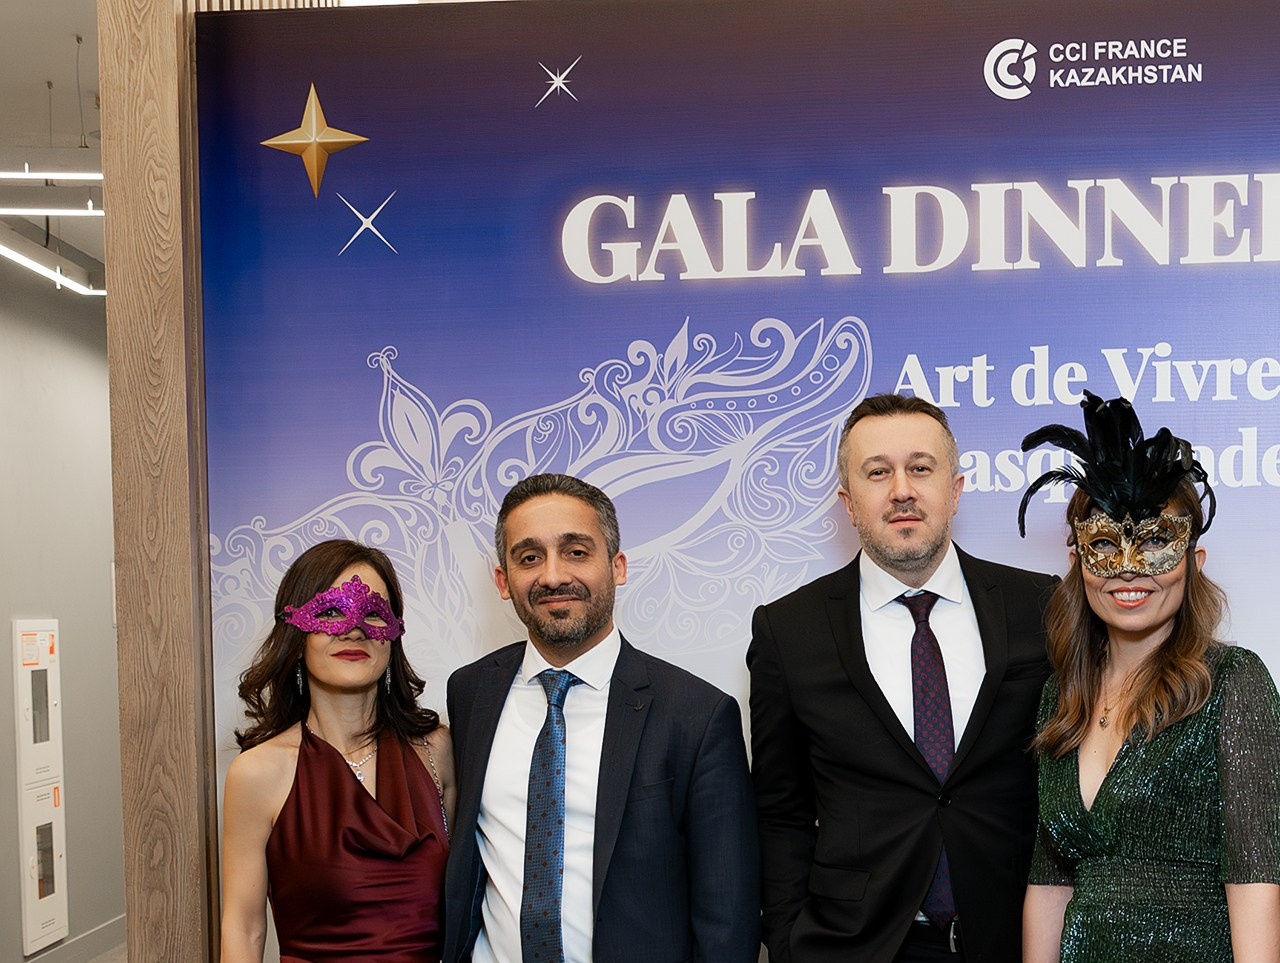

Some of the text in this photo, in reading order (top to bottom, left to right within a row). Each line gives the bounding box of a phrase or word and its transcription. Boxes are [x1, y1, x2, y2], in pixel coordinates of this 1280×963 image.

[1050, 38, 1187, 62] CCI FRANCE
[1050, 63, 1203, 88] KAZAKHSTAN
[561, 187, 862, 284] GALA
[893, 353, 996, 408] Art
[1010, 345, 1088, 406] de
